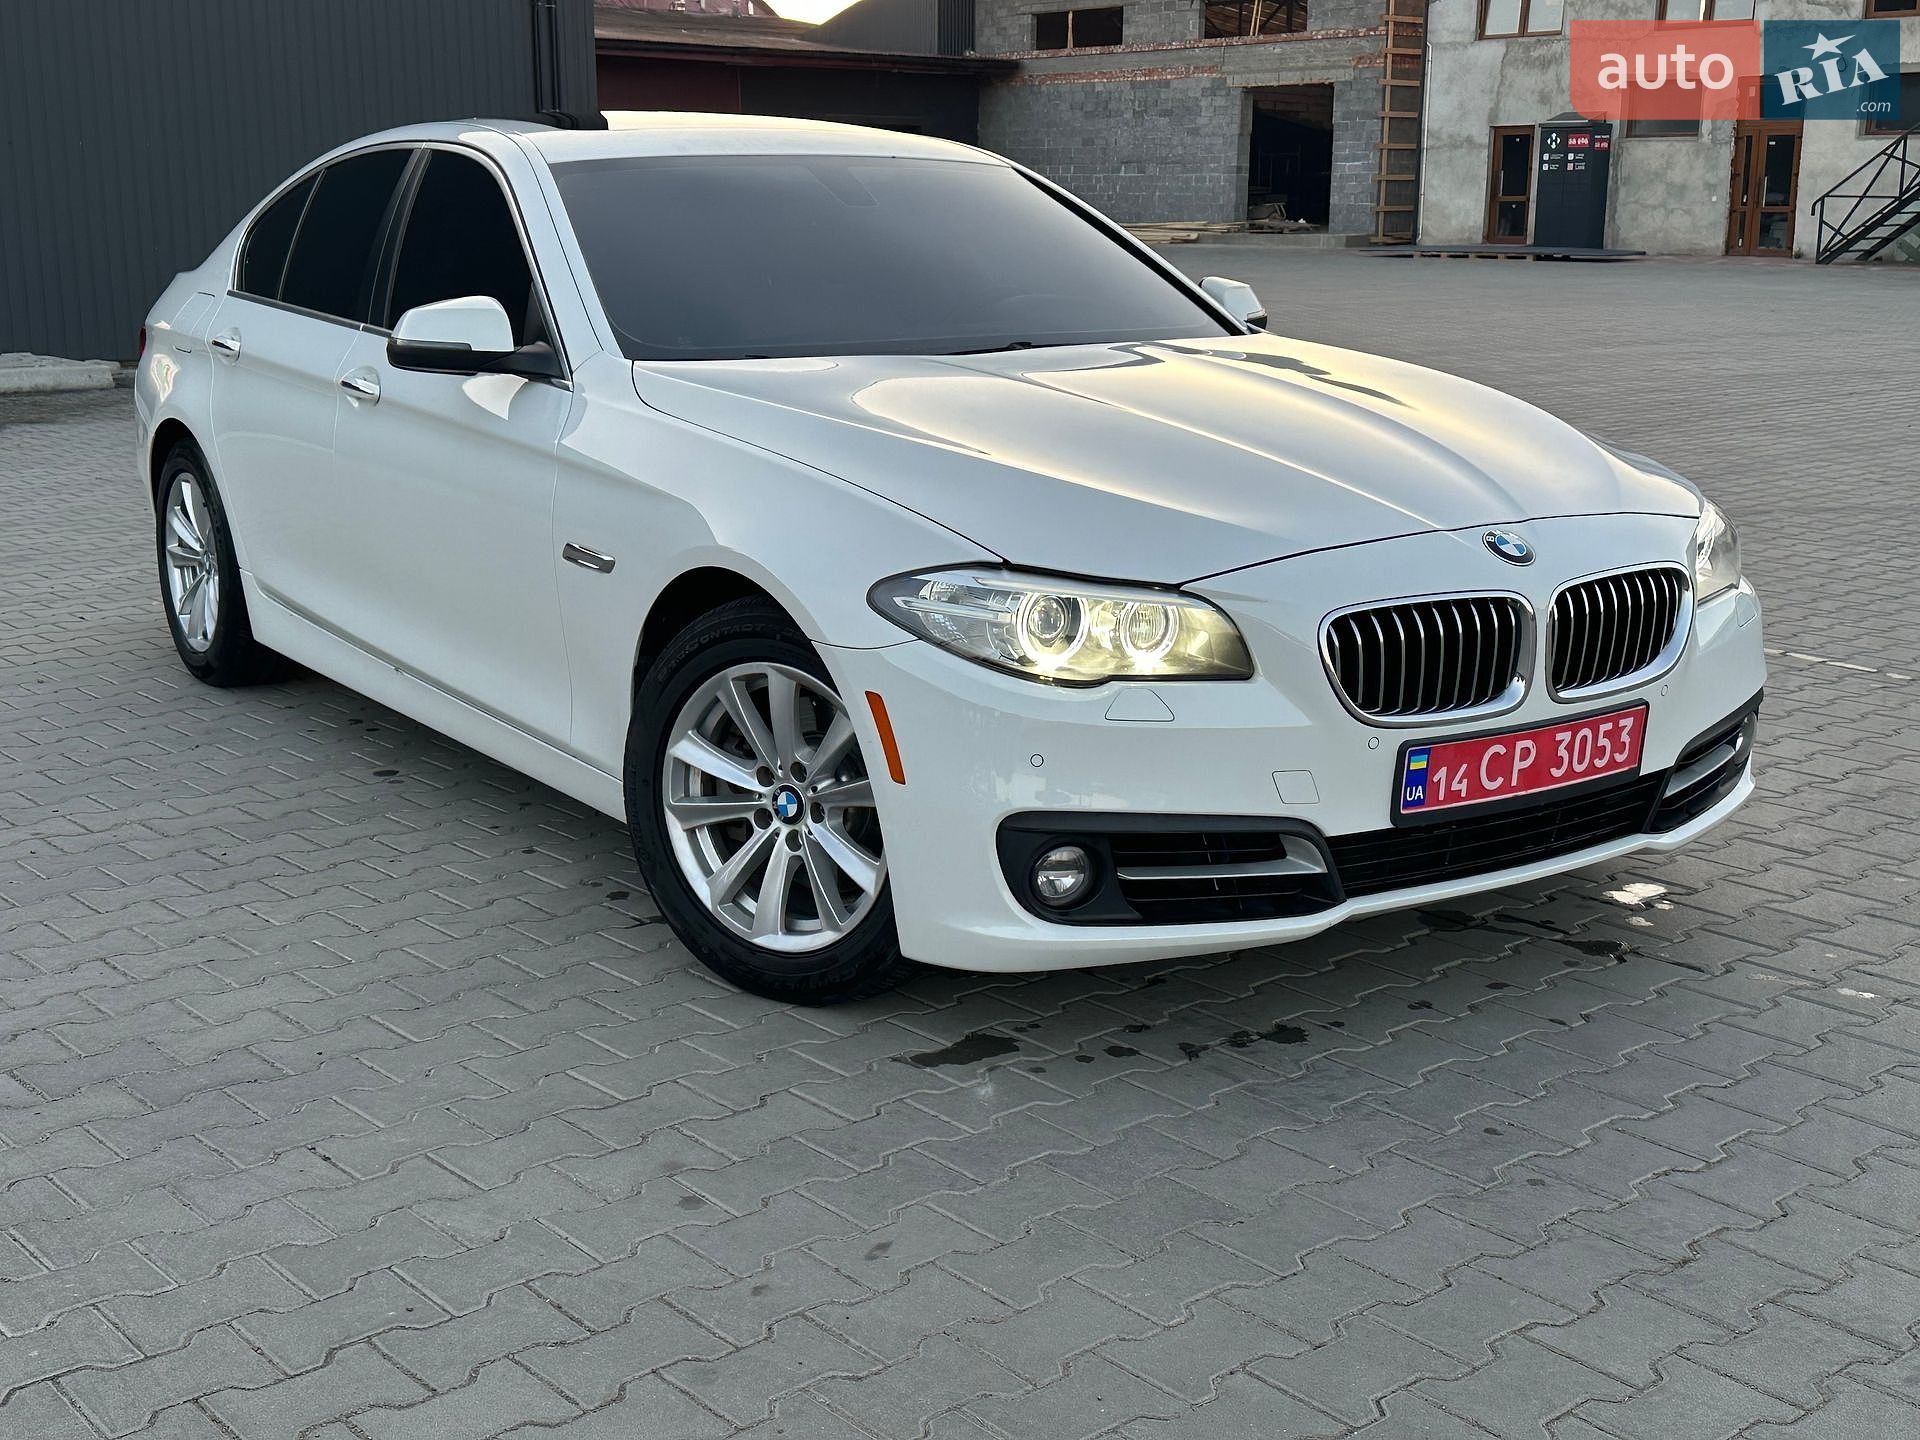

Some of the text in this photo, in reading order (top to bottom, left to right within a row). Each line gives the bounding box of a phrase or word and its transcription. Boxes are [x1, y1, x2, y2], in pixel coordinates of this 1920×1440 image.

[1432, 716, 1635, 801] 14 CP 3053
[1406, 785, 1424, 801] UA
